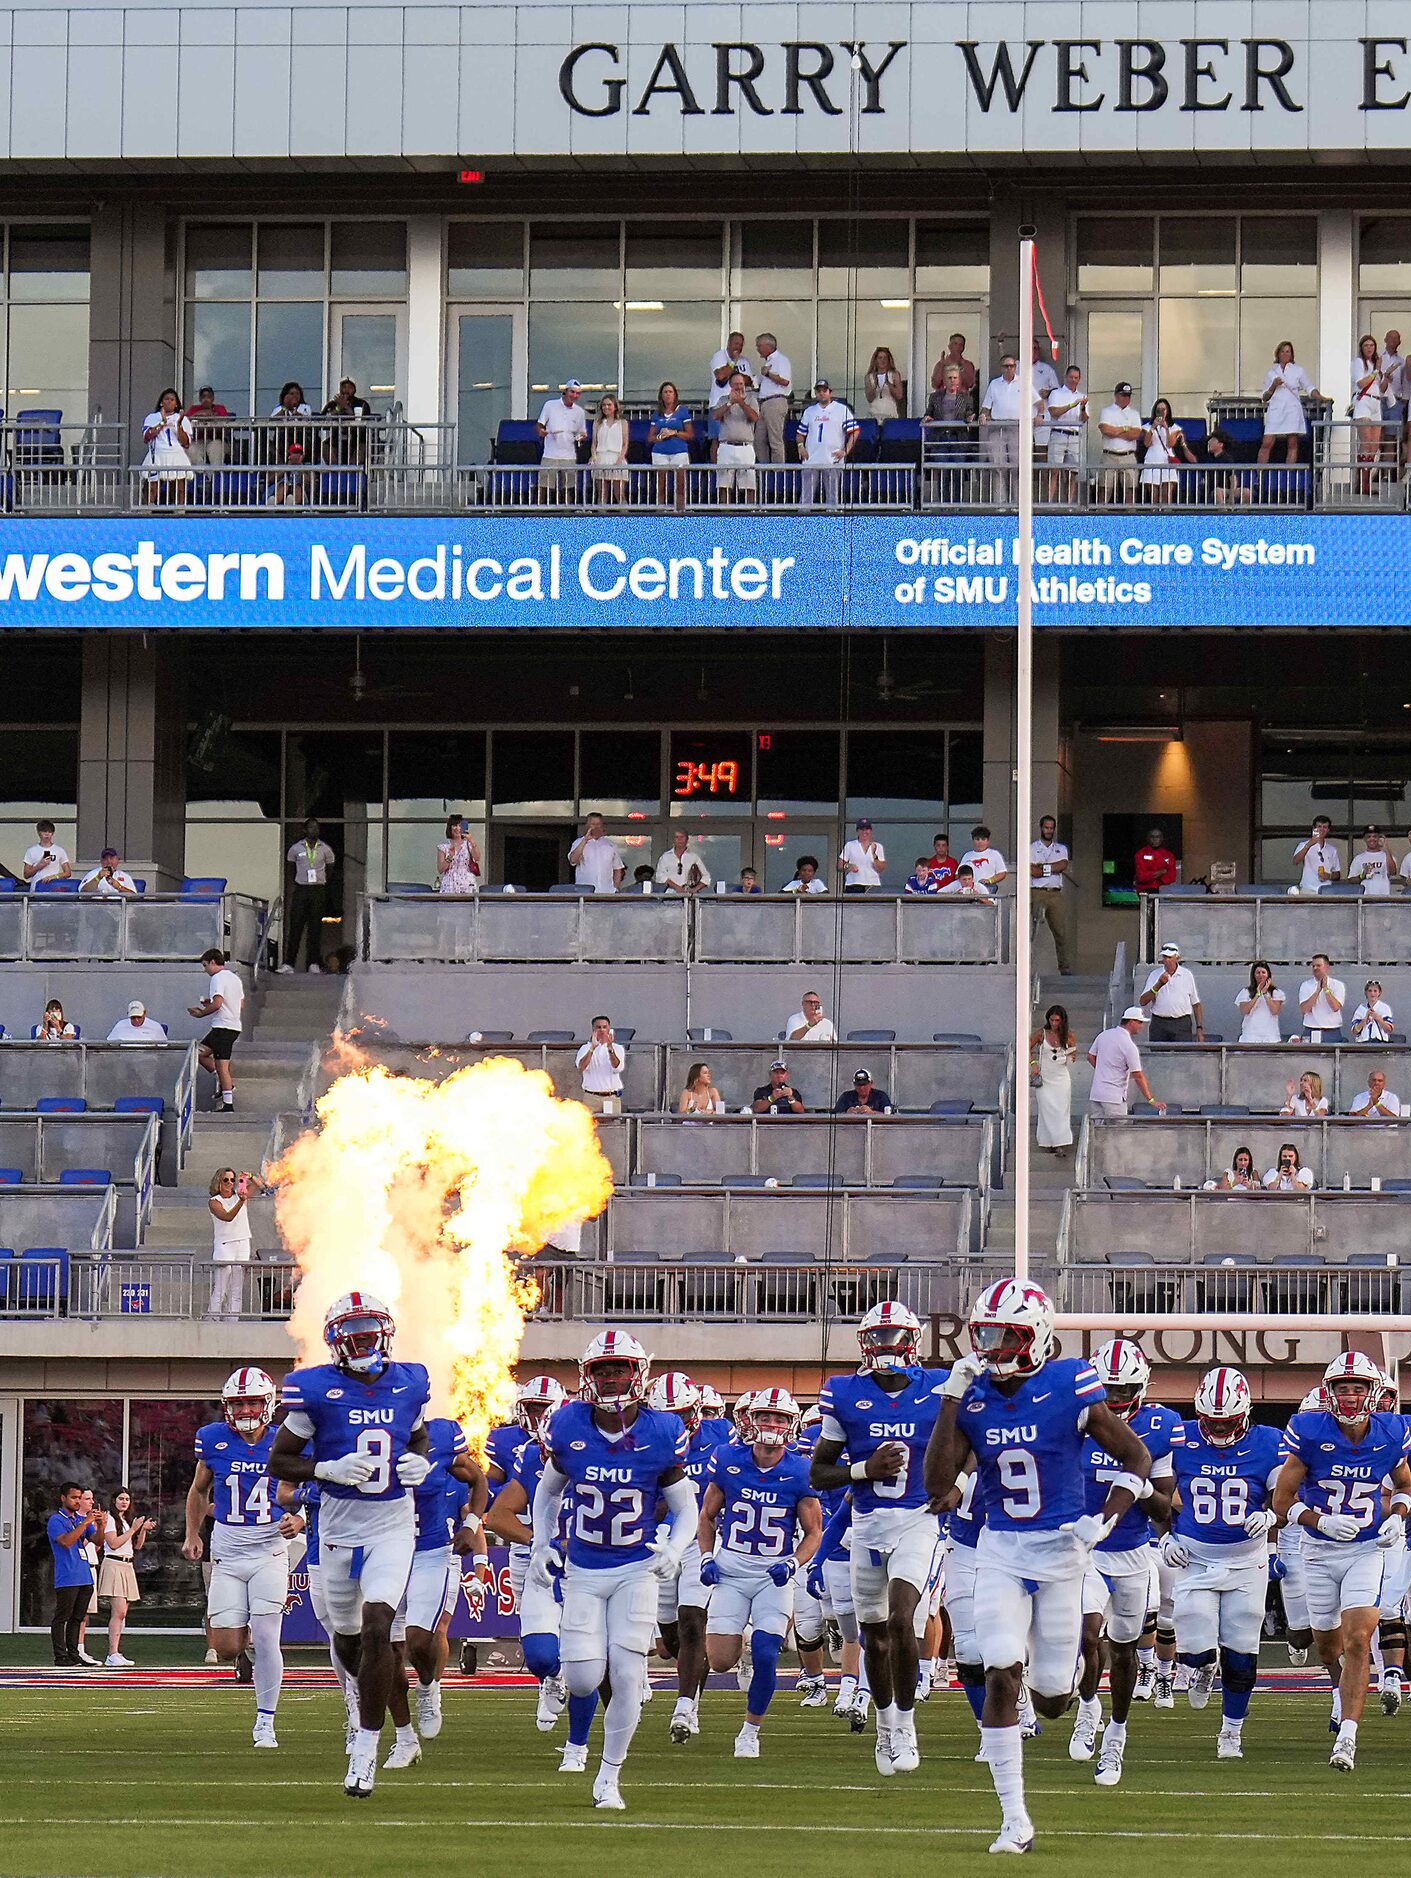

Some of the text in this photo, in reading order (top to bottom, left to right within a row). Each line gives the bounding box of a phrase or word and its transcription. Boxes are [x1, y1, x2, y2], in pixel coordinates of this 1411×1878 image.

[560, 41, 907, 117] GARRY
[956, 39, 1303, 113] WEBER
[895, 538, 1003, 566] Official
[1119, 538, 1193, 566] Care
[1202, 537, 1316, 571] System
[311, 545, 560, 601] Medical
[579, 543, 794, 601] Center
[894, 576, 926, 604] of
[933, 576, 1008, 604] SMU
[675, 760, 739, 795] 3:49
[349, 1408, 394, 1425] SMU
[869, 1422, 916, 1438] SMU
[1150, 1416, 1162, 1430] C
[985, 1424, 1038, 1445] SMU
[230, 1461, 268, 1475] SMU
[1090, 1451, 1118, 1467] SM
[1200, 1464, 1237, 1476] SMU
[1330, 1464, 1372, 1479] SMU
[584, 1466, 632, 1483] SMU
[996, 1448, 1041, 1518] 9
[225, 1474, 272, 1525] 14
[740, 1487, 778, 1504] SMU
[1190, 1477, 1248, 1526] 68
[1314, 1479, 1380, 1529] 35
[575, 1483, 643, 1547] 22
[726, 1500, 788, 1558] 25
